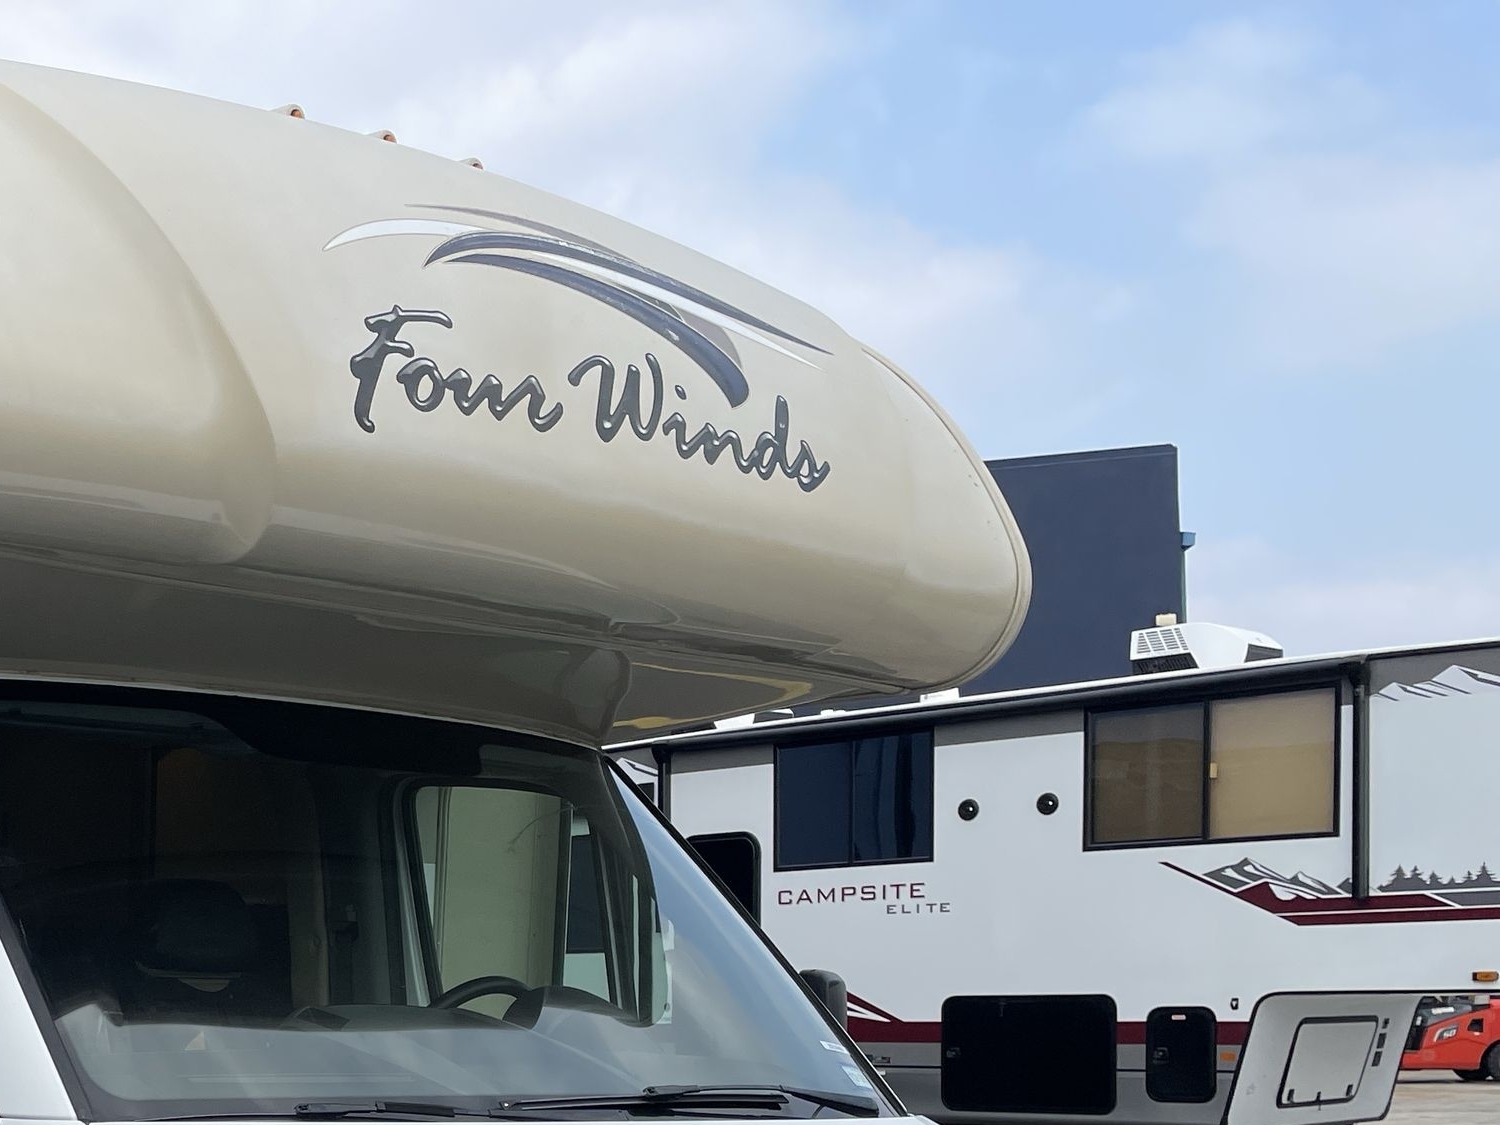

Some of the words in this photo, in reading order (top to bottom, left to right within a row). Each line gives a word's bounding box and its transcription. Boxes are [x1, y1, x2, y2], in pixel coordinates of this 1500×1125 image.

[350, 304, 563, 434] Four
[567, 352, 831, 493] Winds
[777, 882, 926, 905] CAMPSITE
[886, 902, 951, 915] ELITE
